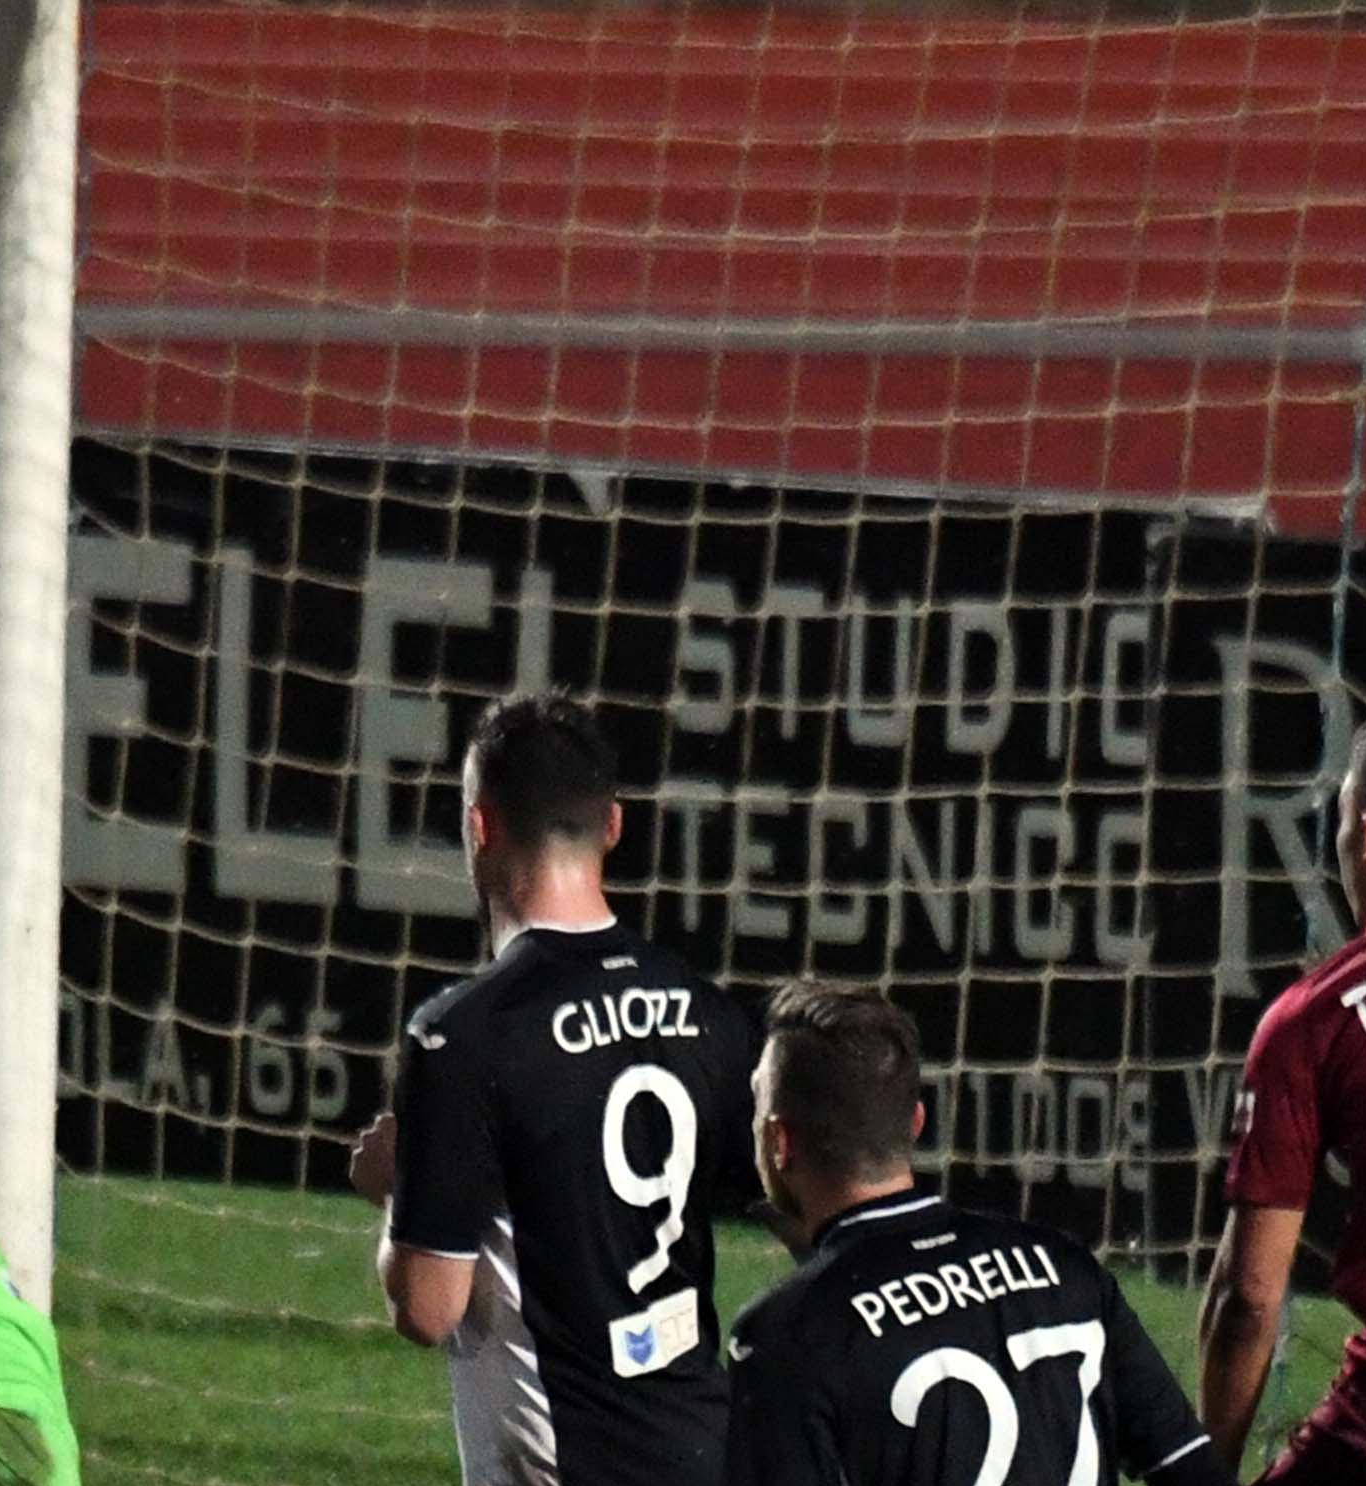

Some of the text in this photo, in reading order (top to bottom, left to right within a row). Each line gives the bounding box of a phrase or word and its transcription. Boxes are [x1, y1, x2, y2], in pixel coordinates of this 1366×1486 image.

[552, 987, 699, 1054] GLIOZZ
[602, 1063, 698, 1295] 9
[850, 1244, 1060, 1338] PEDRELLI
